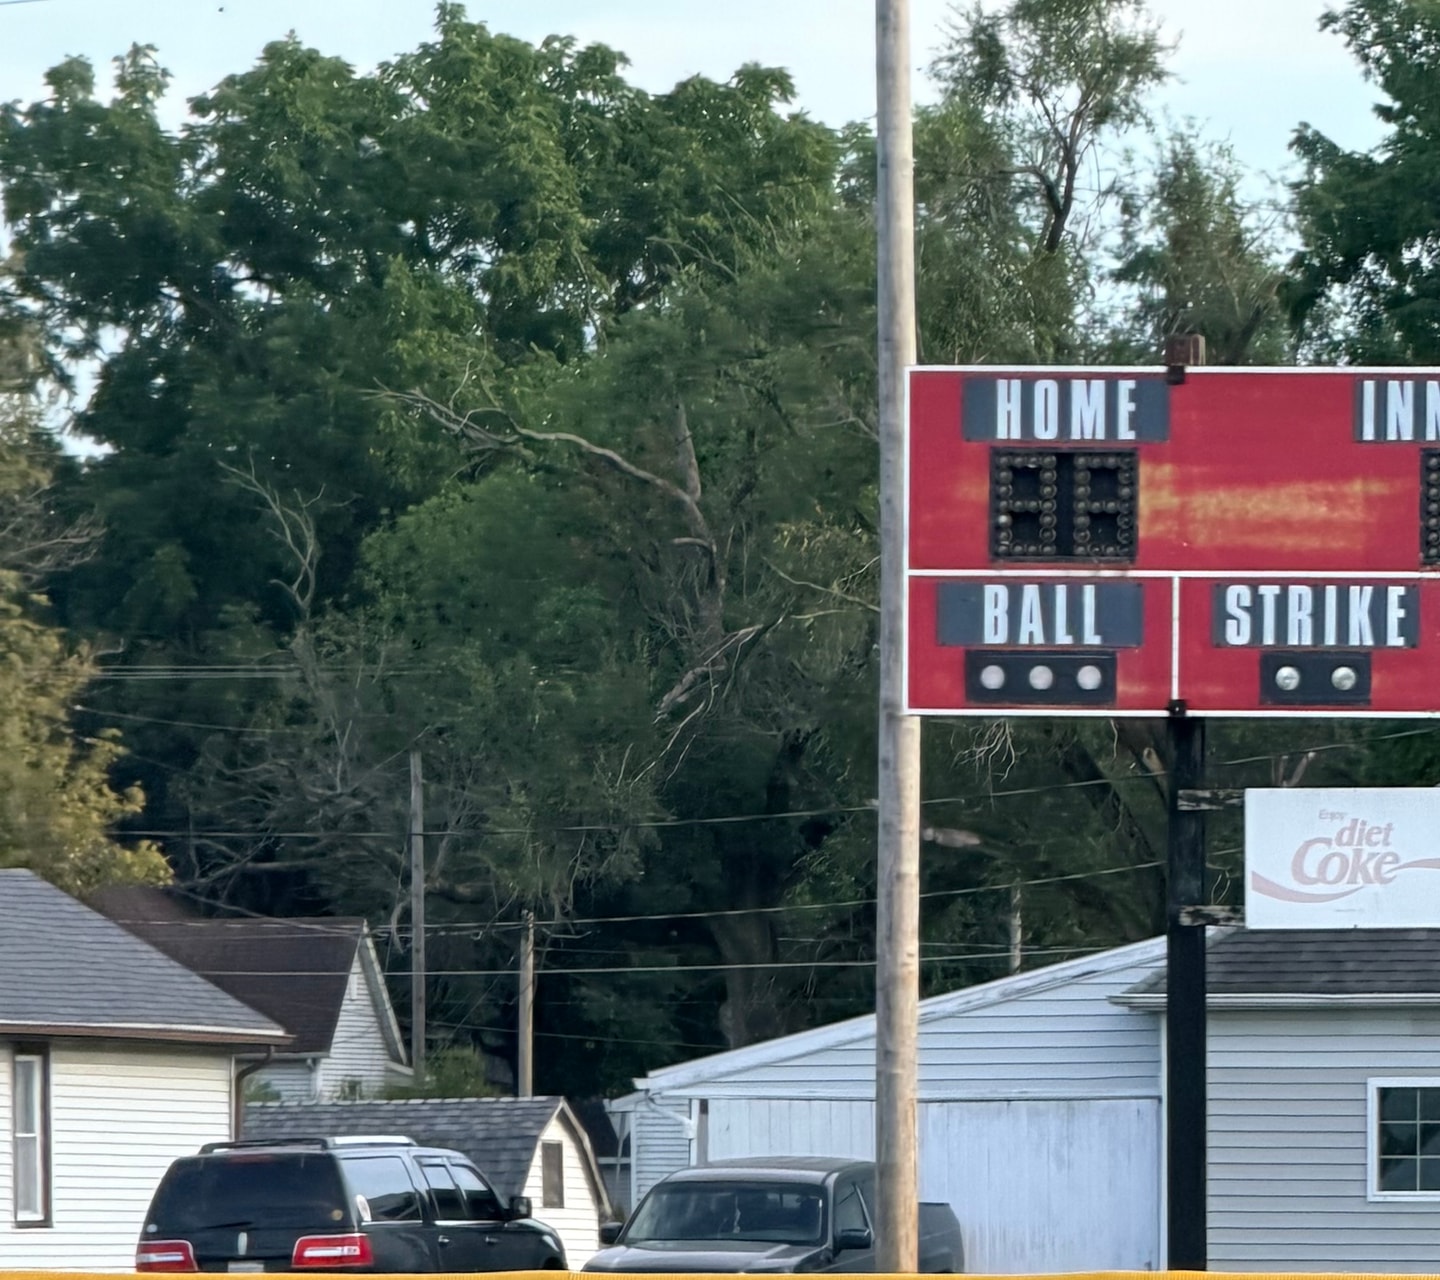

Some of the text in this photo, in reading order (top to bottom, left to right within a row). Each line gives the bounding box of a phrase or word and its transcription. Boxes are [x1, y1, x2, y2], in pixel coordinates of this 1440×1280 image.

[996, 379, 1137, 441] HOME
[983, 583, 1102, 646] BALL
[1225, 585, 1406, 647] STRIKE
[1291, 837, 1400, 885] Coke
[1334, 818, 1394, 847] diet
